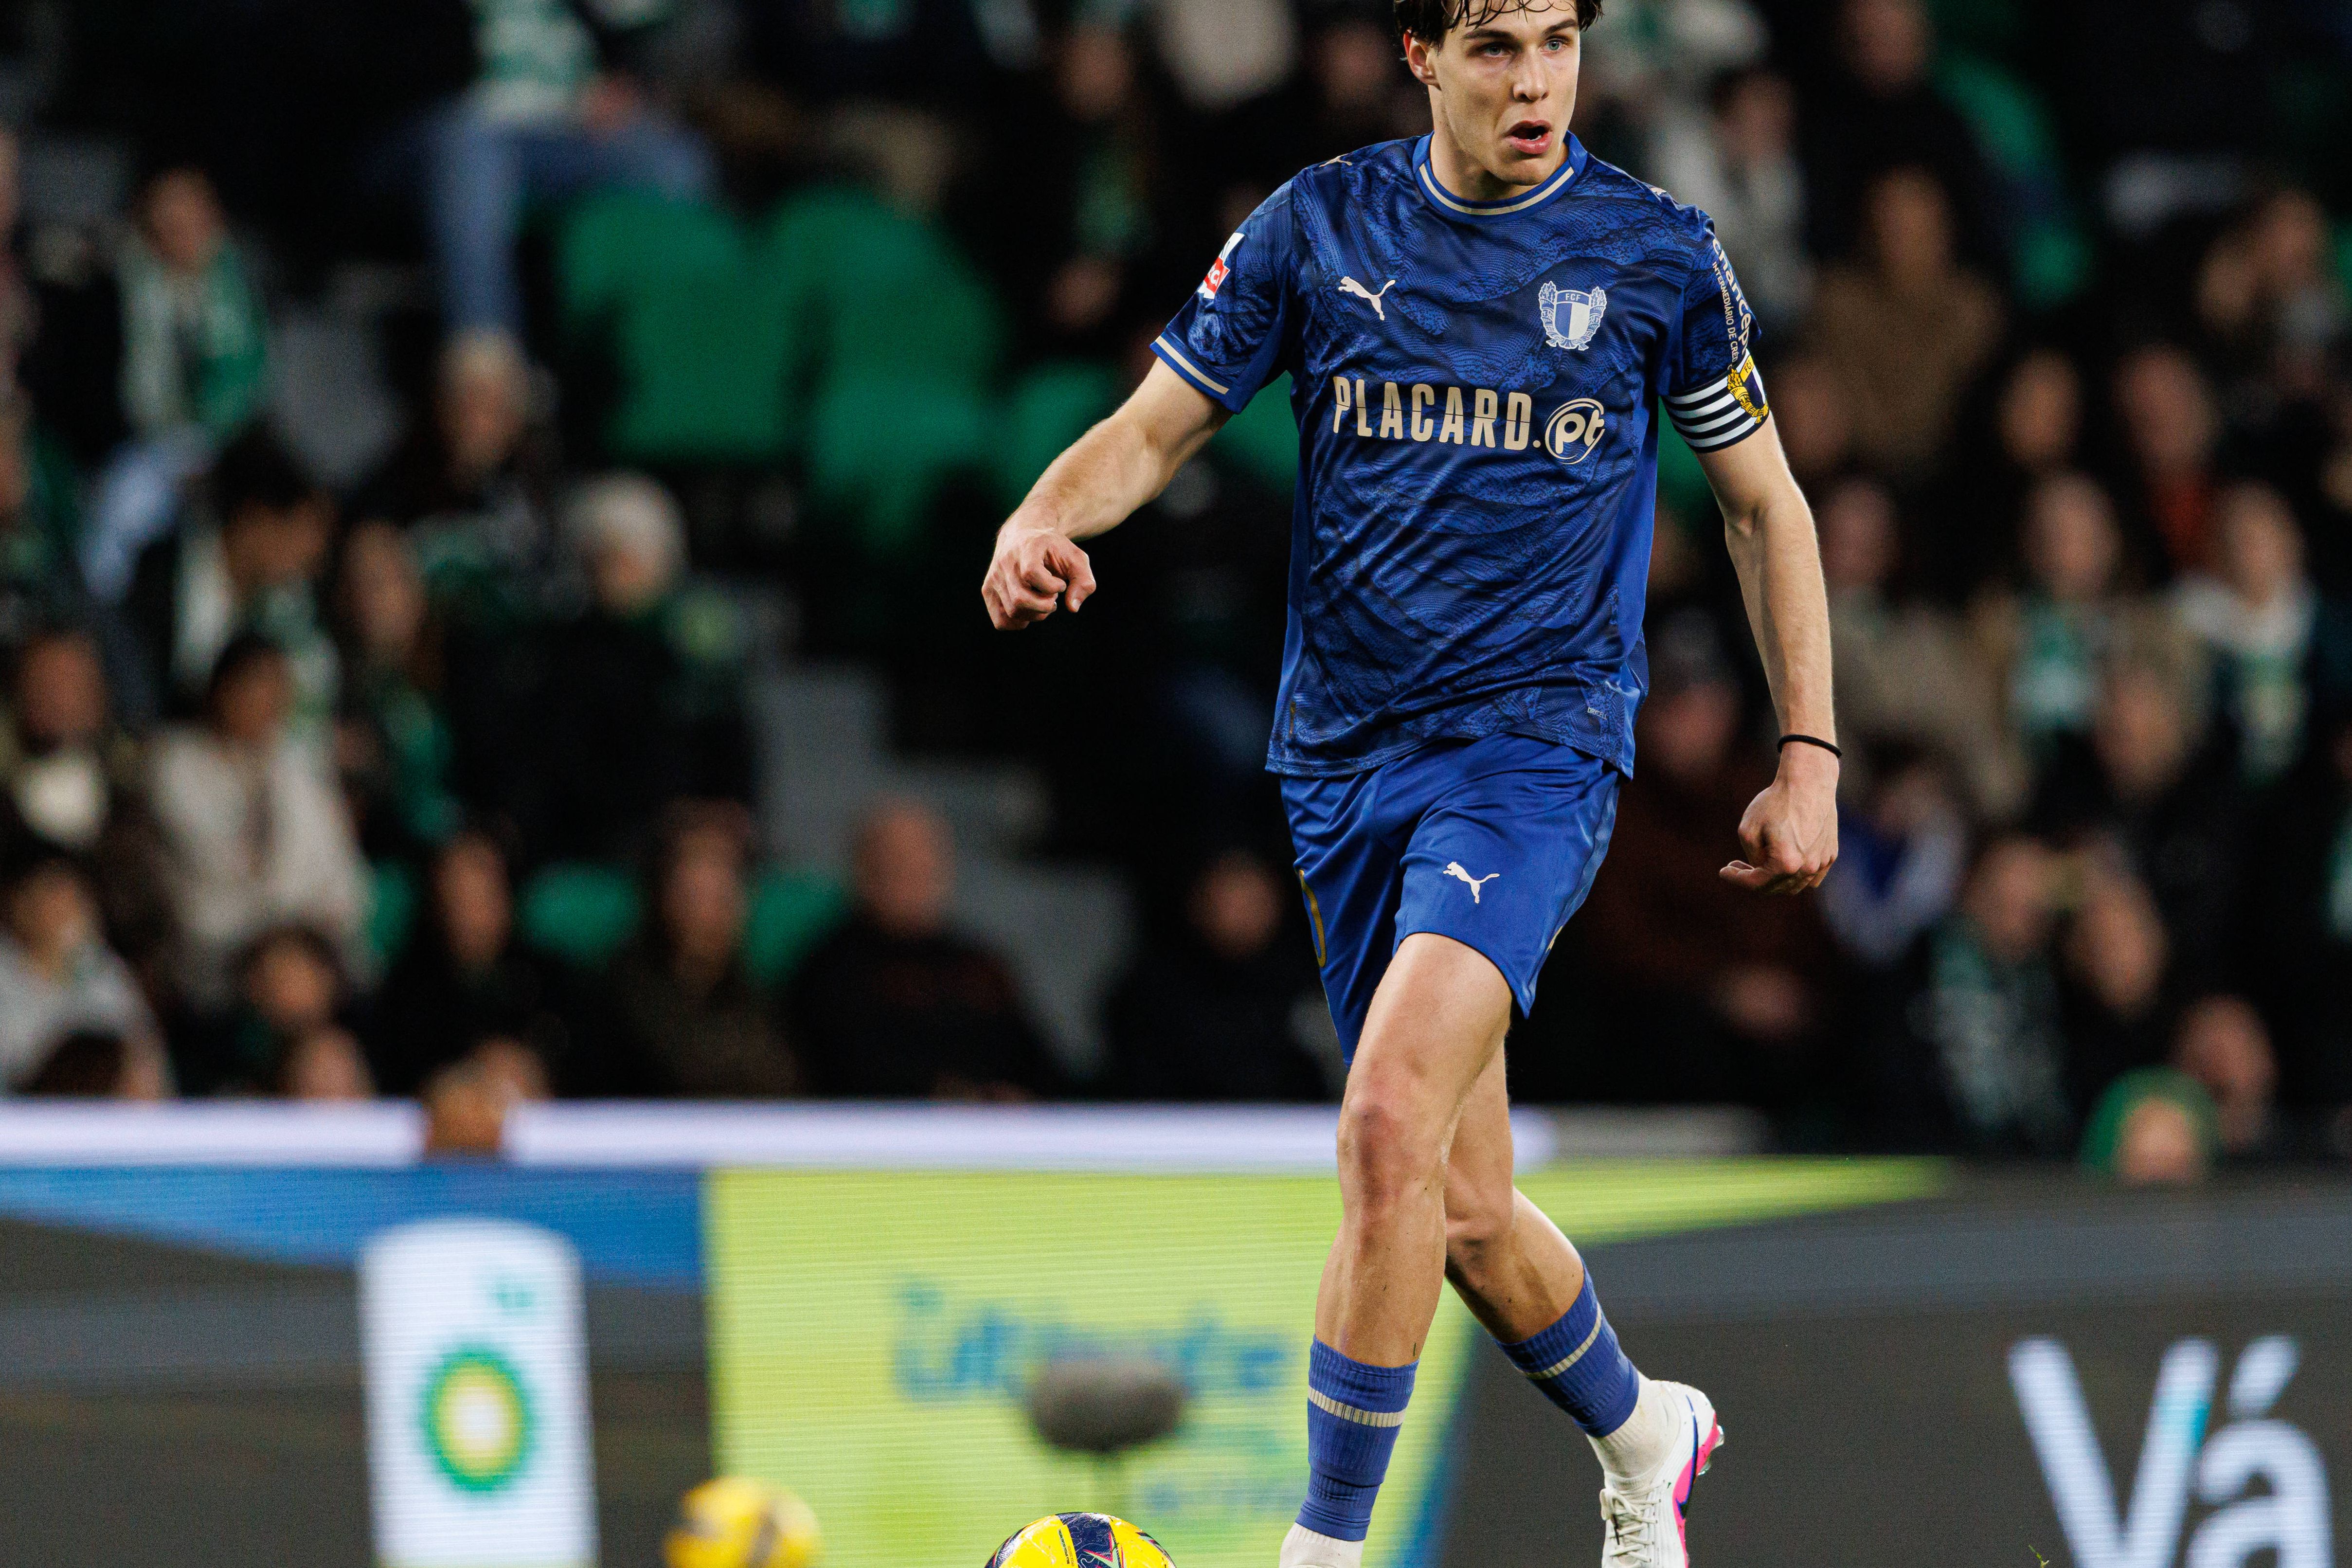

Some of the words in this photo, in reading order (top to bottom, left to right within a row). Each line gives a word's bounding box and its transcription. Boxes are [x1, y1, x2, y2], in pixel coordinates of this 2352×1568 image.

[1565, 293, 1581, 301] FCF
[1712, 261, 1734, 325] INTERMEDIÁRIO
[1727, 327, 1737, 340] DE
[1730, 341, 1740, 362] CRÉD
[1587, 707, 1607, 720] DRYCELL
